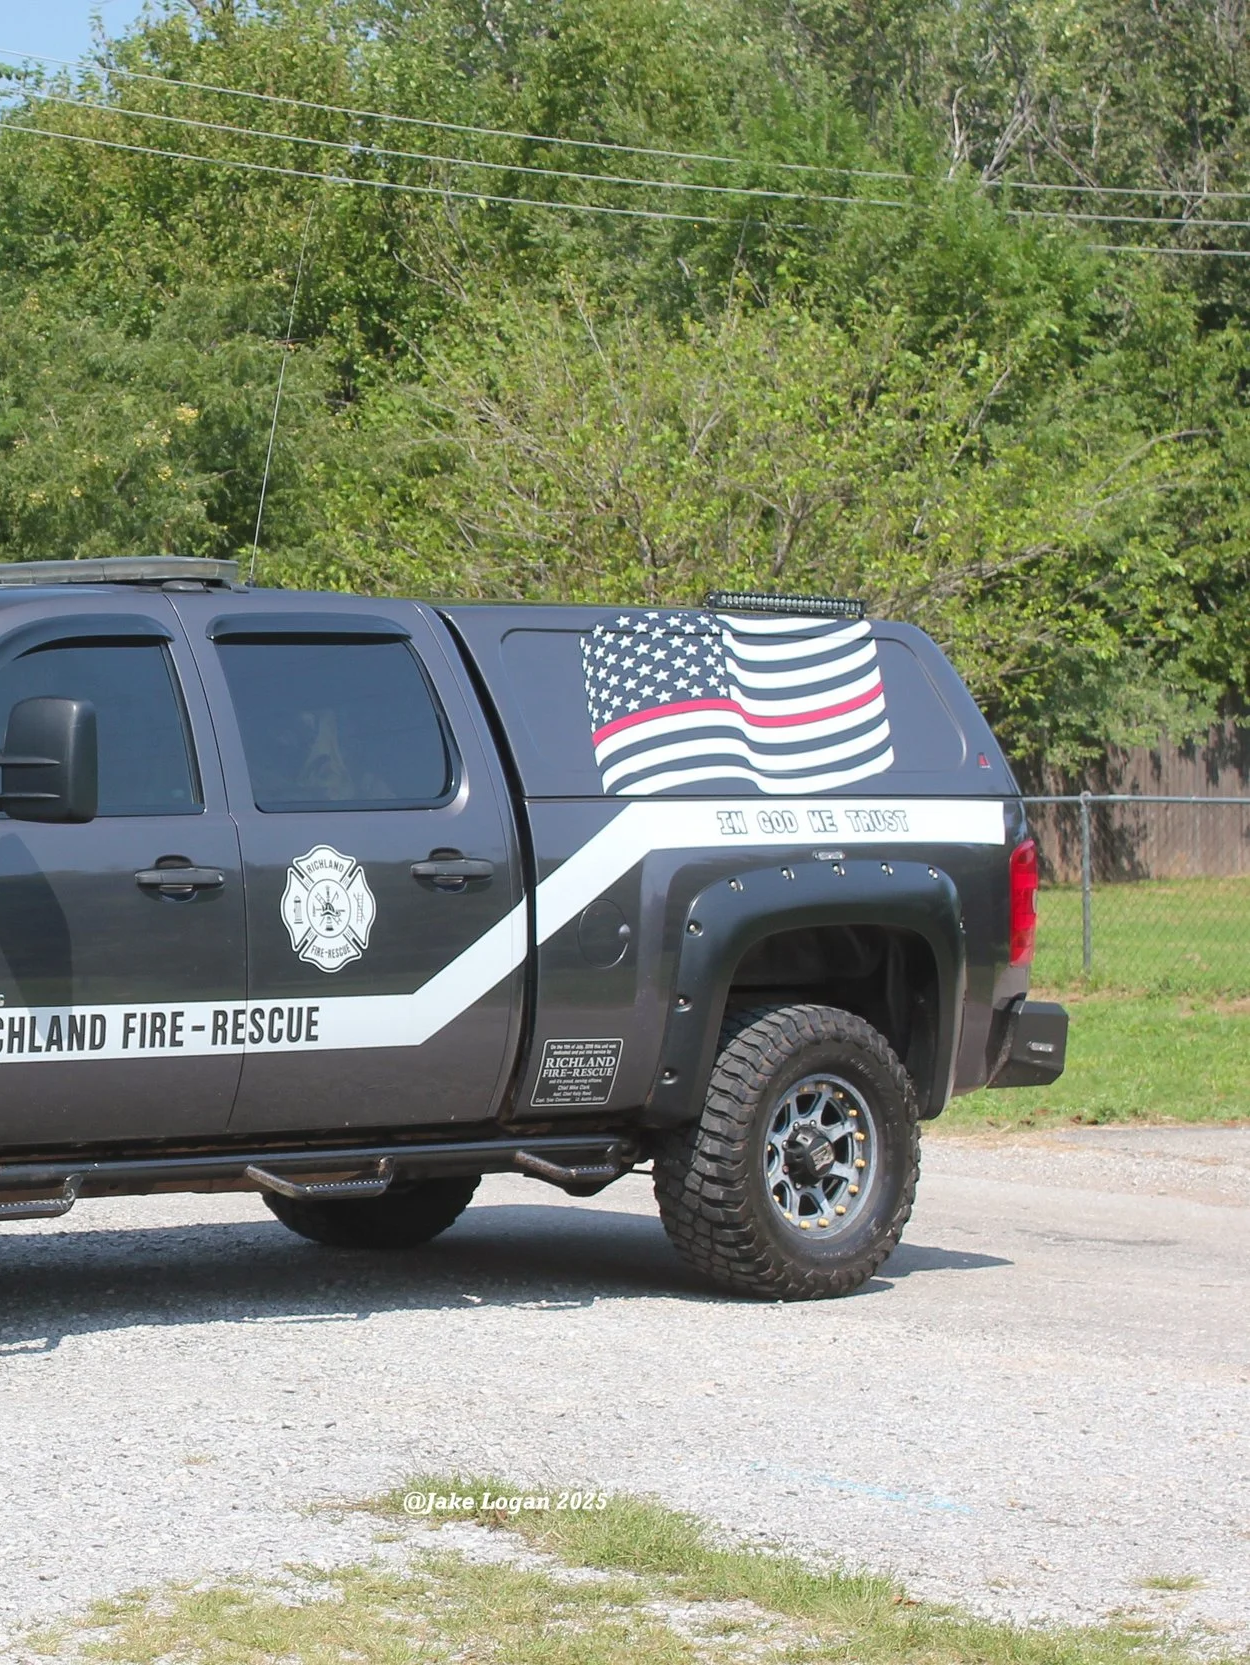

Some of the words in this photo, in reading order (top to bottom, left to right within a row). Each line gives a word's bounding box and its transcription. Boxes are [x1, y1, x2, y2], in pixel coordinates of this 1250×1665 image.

[716, 811, 748, 835] IN
[756, 810, 799, 833] GOD
[807, 810, 838, 832] WE
[845, 809, 909, 832] TRUST
[306, 859, 344, 874] RICHLAND
[310, 944, 351, 959] FIRE-RESCUE
[122, 1006, 320, 1049] FIRE-RESCUE
[544, 1056, 616, 1068] RICHLAND
[542, 1067, 614, 1078] FIRE-RESCUE
